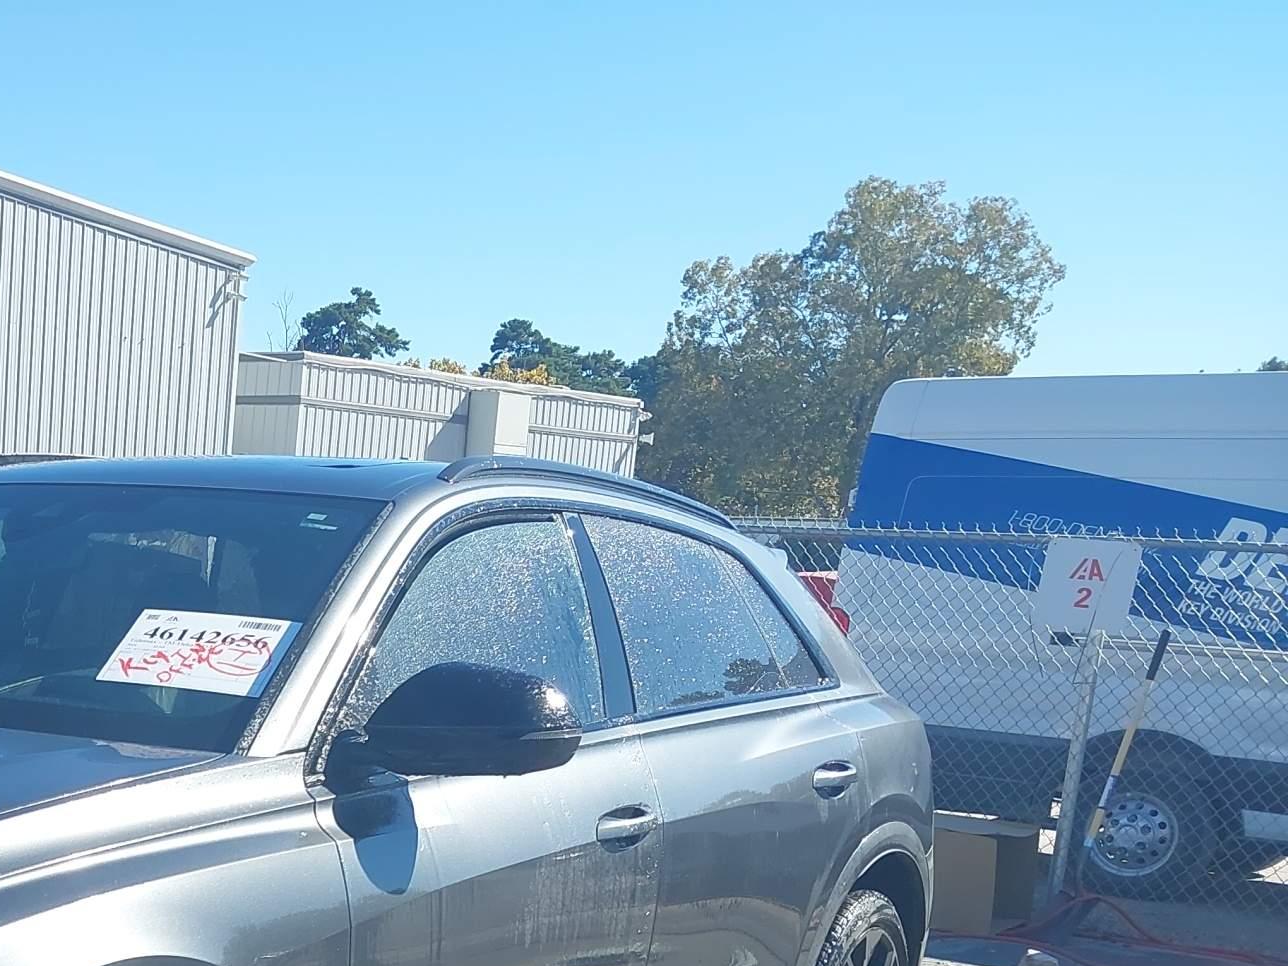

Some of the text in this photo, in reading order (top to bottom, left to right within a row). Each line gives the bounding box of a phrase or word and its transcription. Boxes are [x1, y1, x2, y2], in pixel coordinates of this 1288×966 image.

[1072, 587, 1092, 609] 2
[1187, 579, 1284, 614] THE WORLD
[1177, 599, 1283, 635] KEY DIVISION
[143, 625, 272, 650] 46142656
